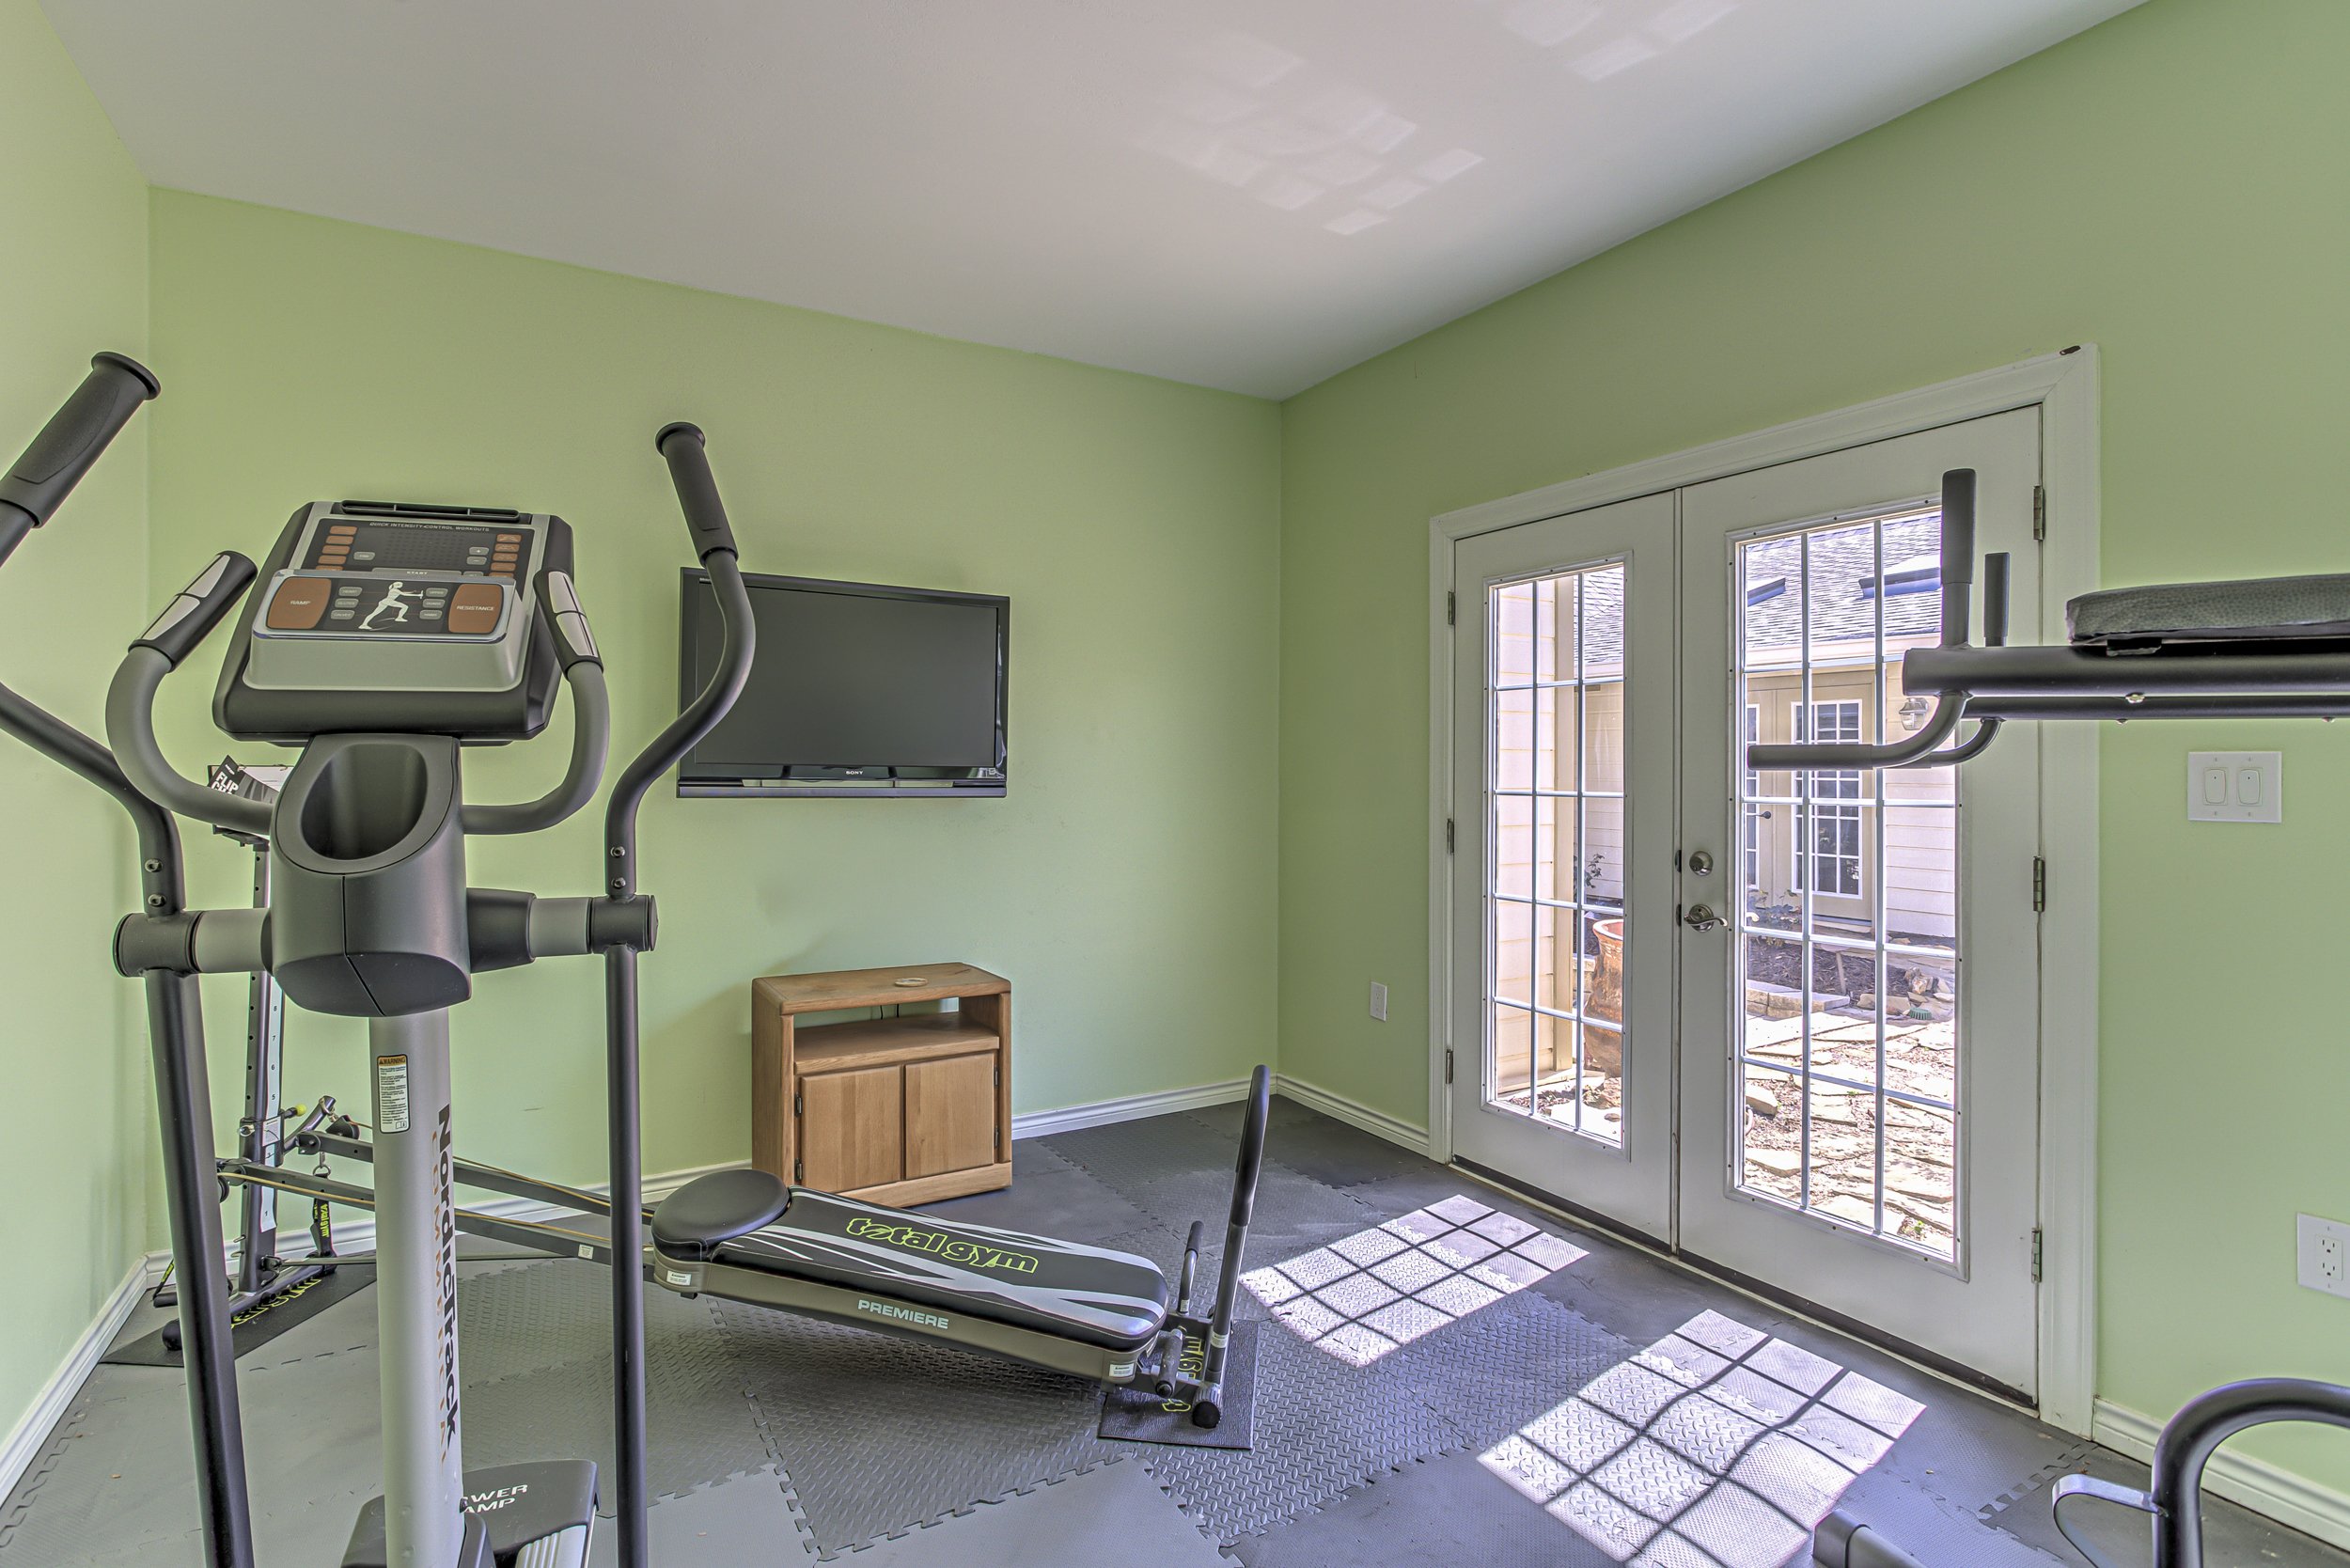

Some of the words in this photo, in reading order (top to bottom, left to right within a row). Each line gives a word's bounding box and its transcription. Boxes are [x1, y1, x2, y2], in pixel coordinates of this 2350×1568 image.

[216, 772, 239, 792] FLIP
[846, 1217, 948, 1253] total
[941, 1241, 1039, 1274] gym
[438, 1103, 459, 1451] NordicTrack
[857, 1299, 949, 1329] PREMIERE
[462, 1484, 528, 1503] WER
[463, 1497, 516, 1513] AMP
